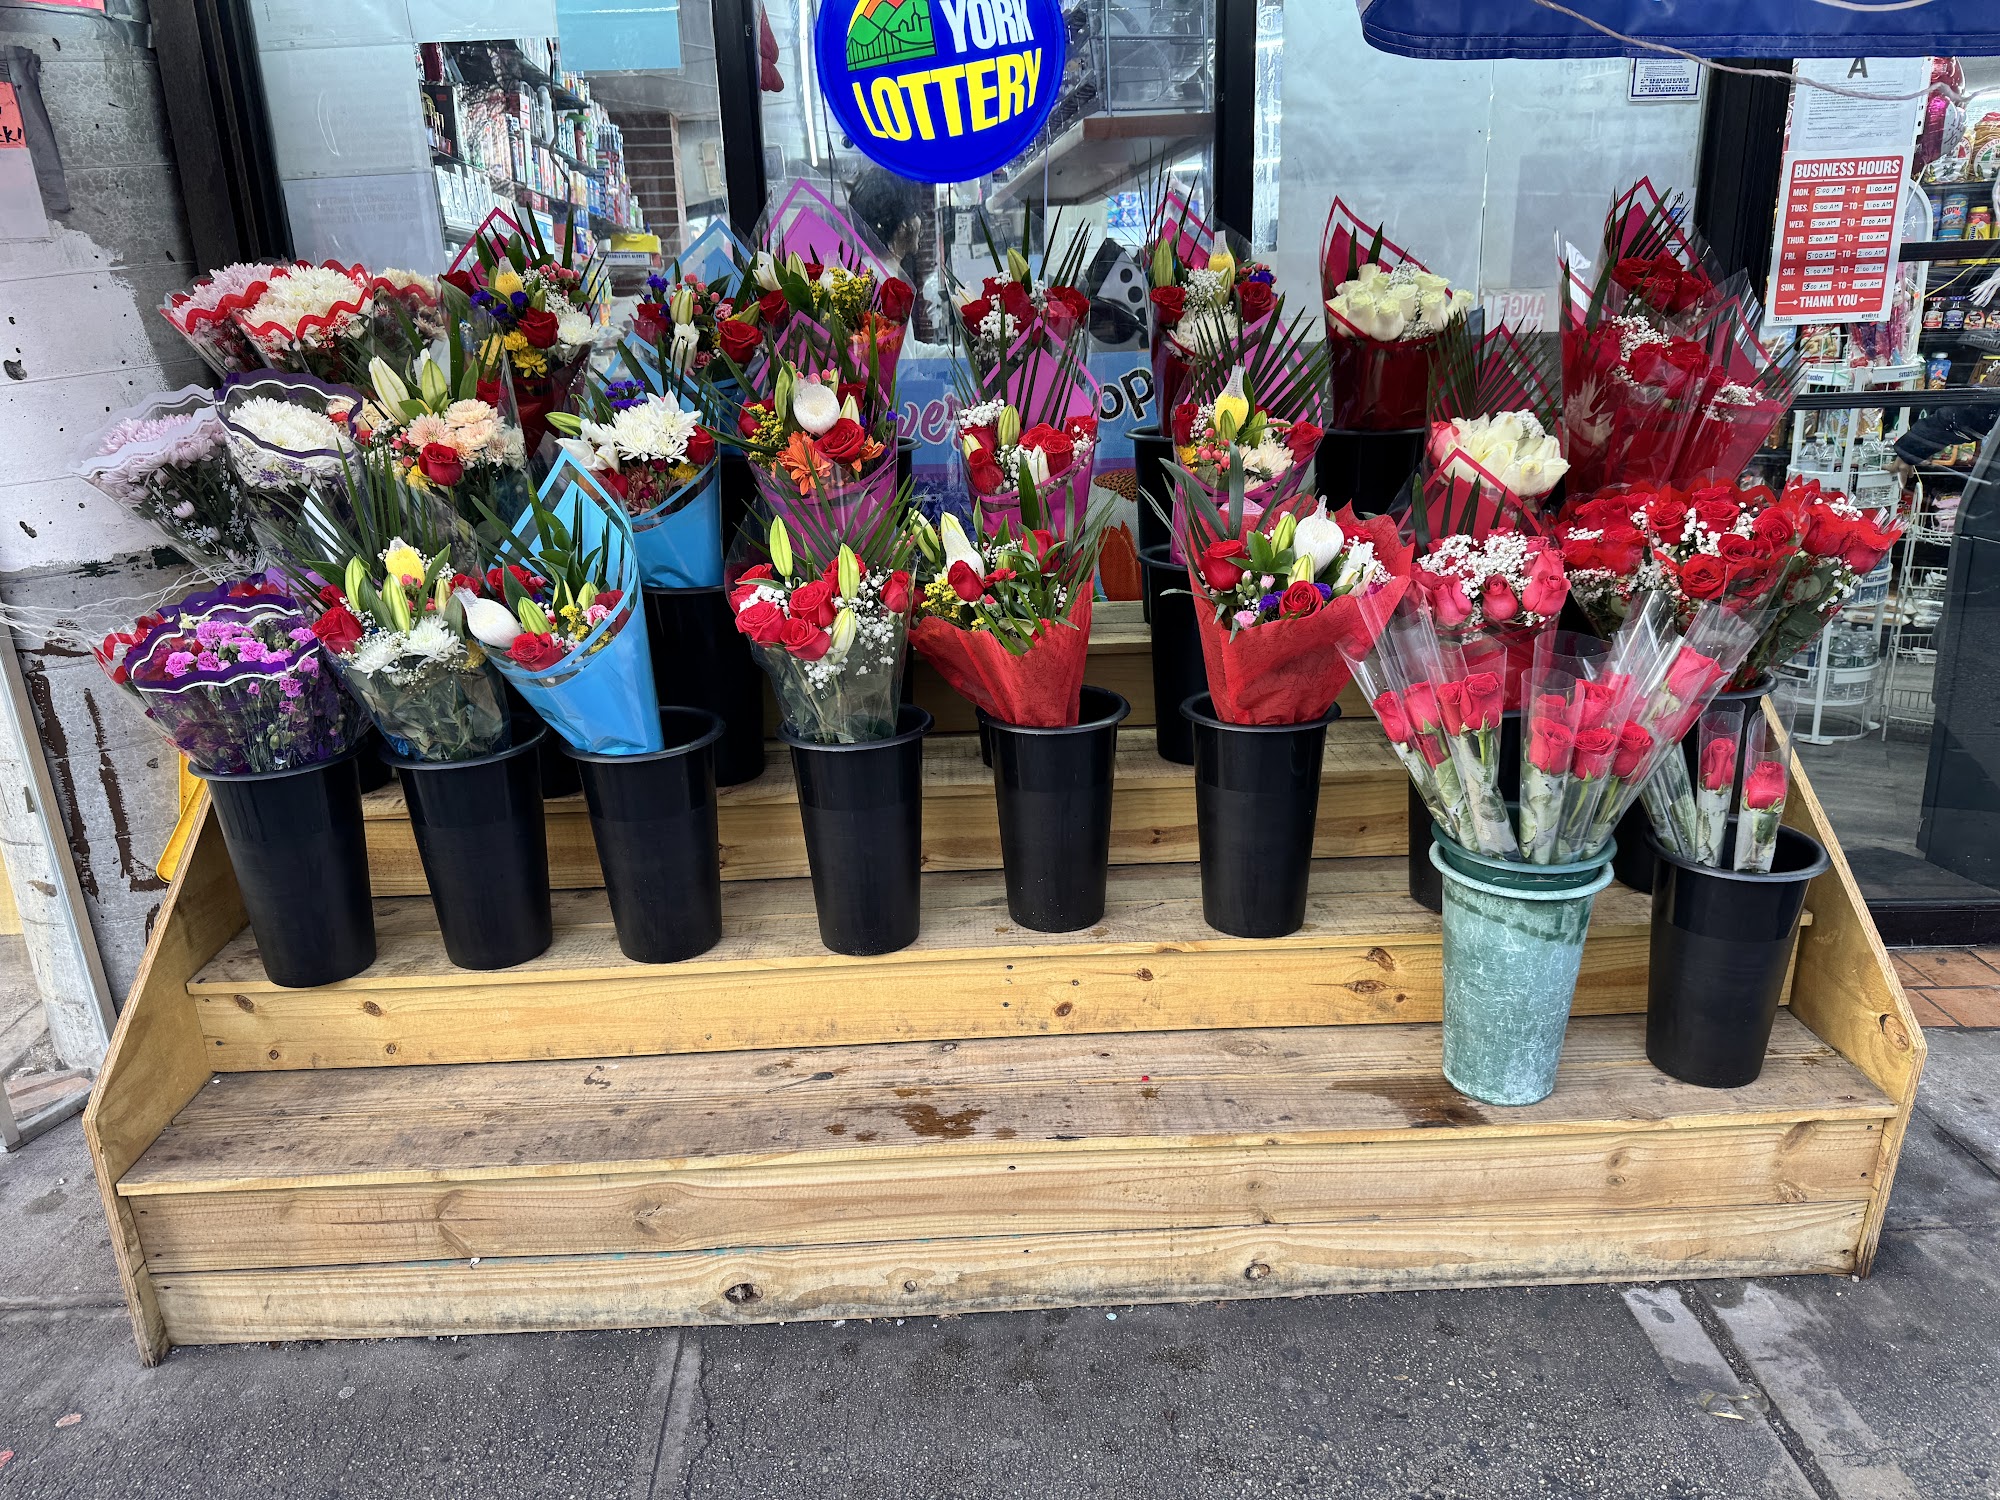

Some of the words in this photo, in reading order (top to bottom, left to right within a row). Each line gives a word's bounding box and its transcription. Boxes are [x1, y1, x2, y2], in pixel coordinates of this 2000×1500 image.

[939, 0, 1034, 53] YORK
[1847, 58, 1868, 79] A
[852, 48, 1042, 142] LOTTERY
[1794, 162, 1855, 178] BUSINESS
[1857, 159, 1900, 175] HOURS
[1800, 296, 1834, 308] THANK
[1836, 294, 1858, 306] YOU
